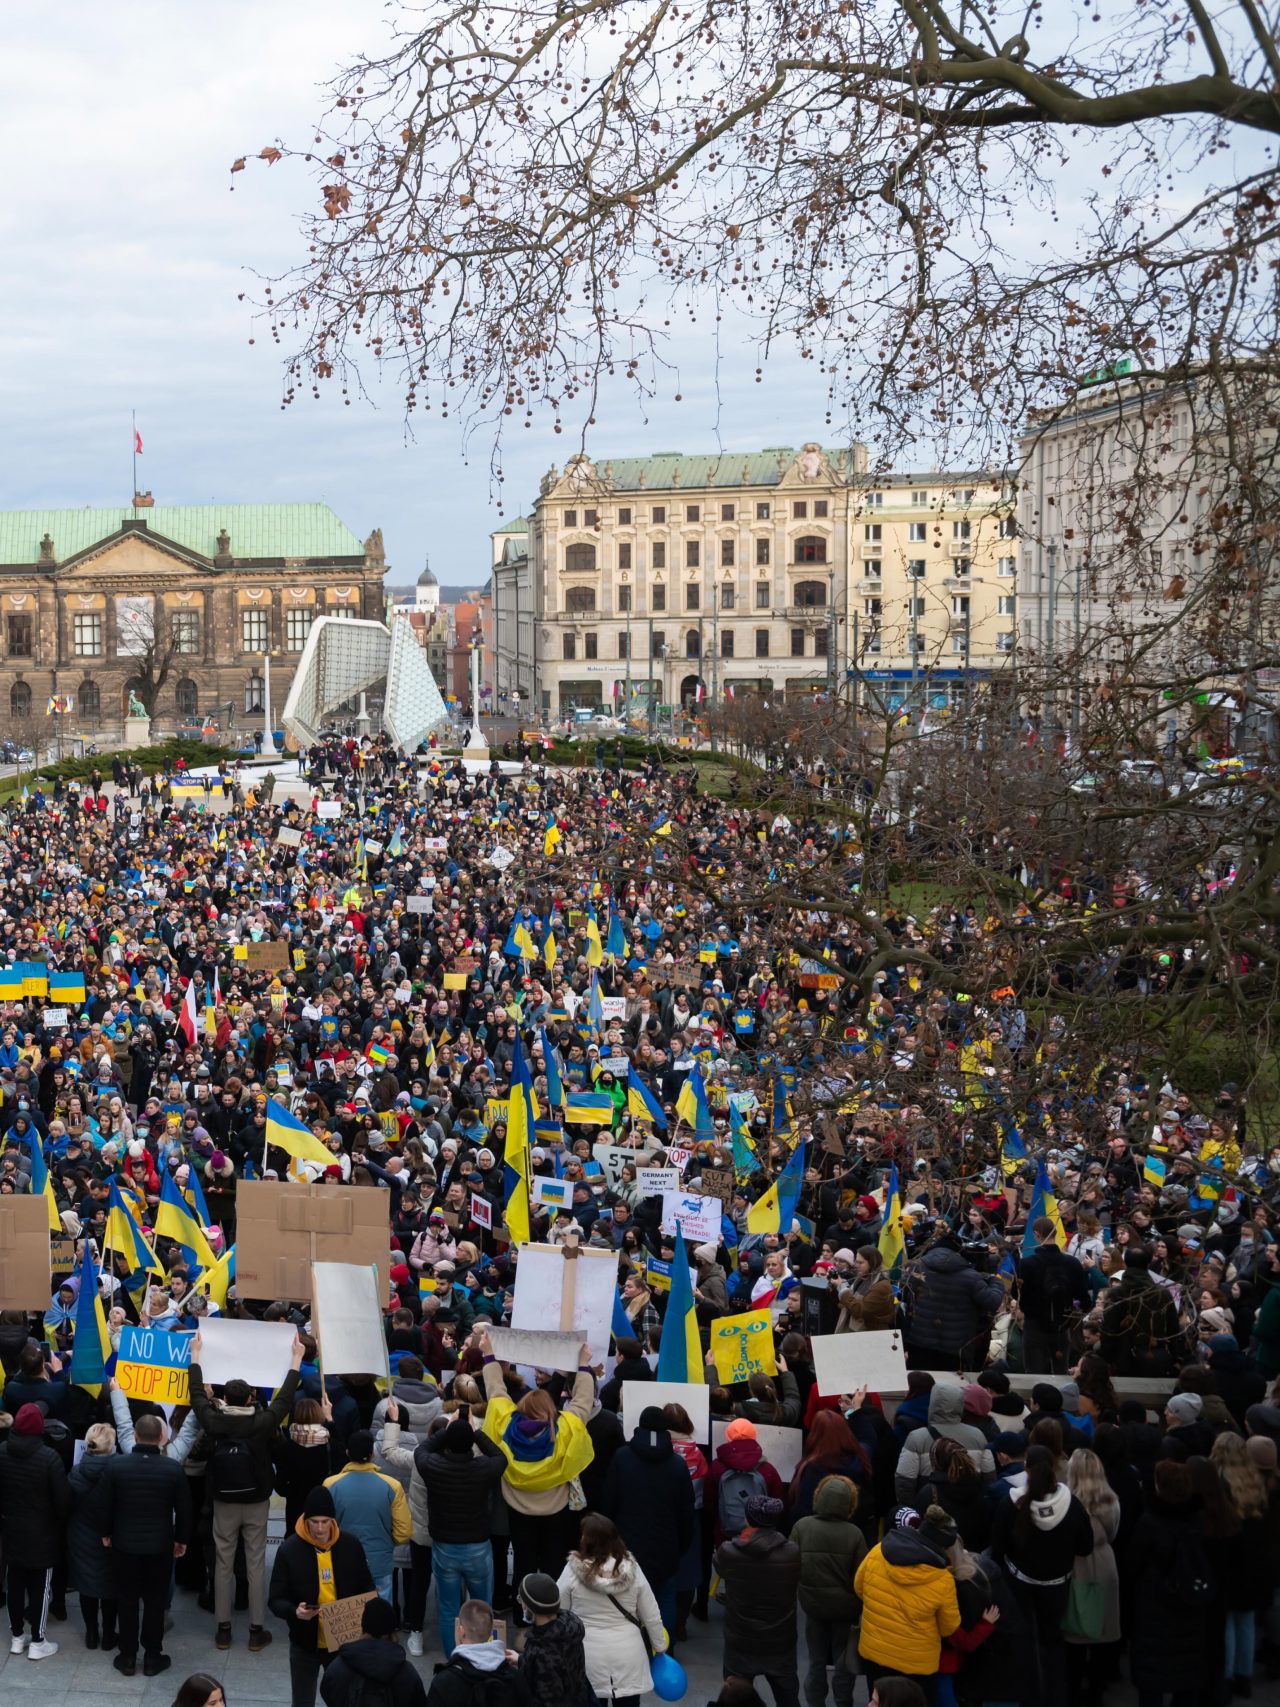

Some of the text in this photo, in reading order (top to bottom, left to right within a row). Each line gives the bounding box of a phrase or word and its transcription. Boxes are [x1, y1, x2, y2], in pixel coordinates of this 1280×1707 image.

[705, 1171, 725, 1181] CUT
[129, 1331, 192, 1363] NO WA
[732, 1359, 761, 1374] LOOK
[120, 1364, 163, 1395] STOP
